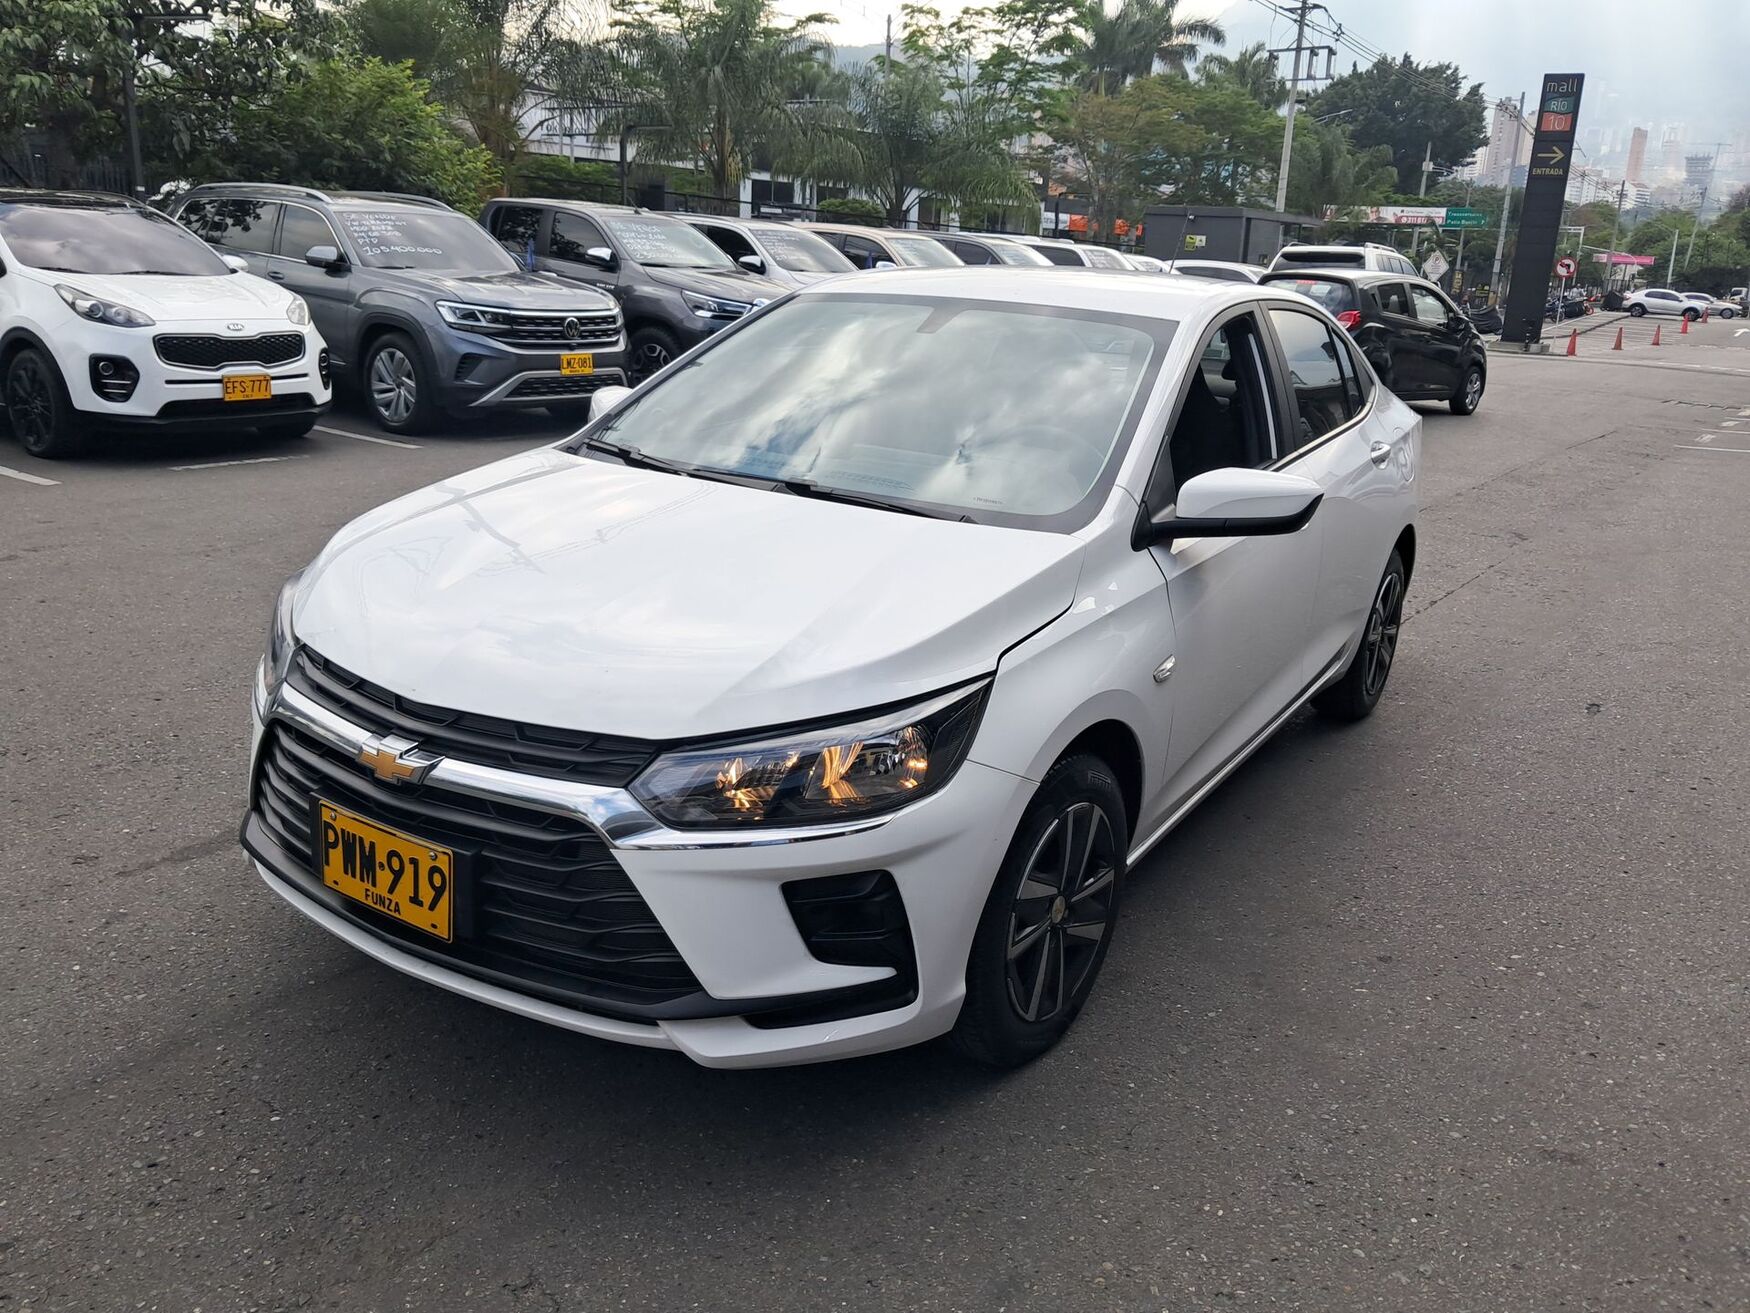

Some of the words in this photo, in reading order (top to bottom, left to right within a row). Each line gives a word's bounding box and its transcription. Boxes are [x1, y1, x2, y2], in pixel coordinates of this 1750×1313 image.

[1546, 78, 1577, 93] mall
[1548, 115, 1565, 130] 10
[1532, 167, 1563, 175] ENTRADA
[363, 888, 402, 915] FUNZA
